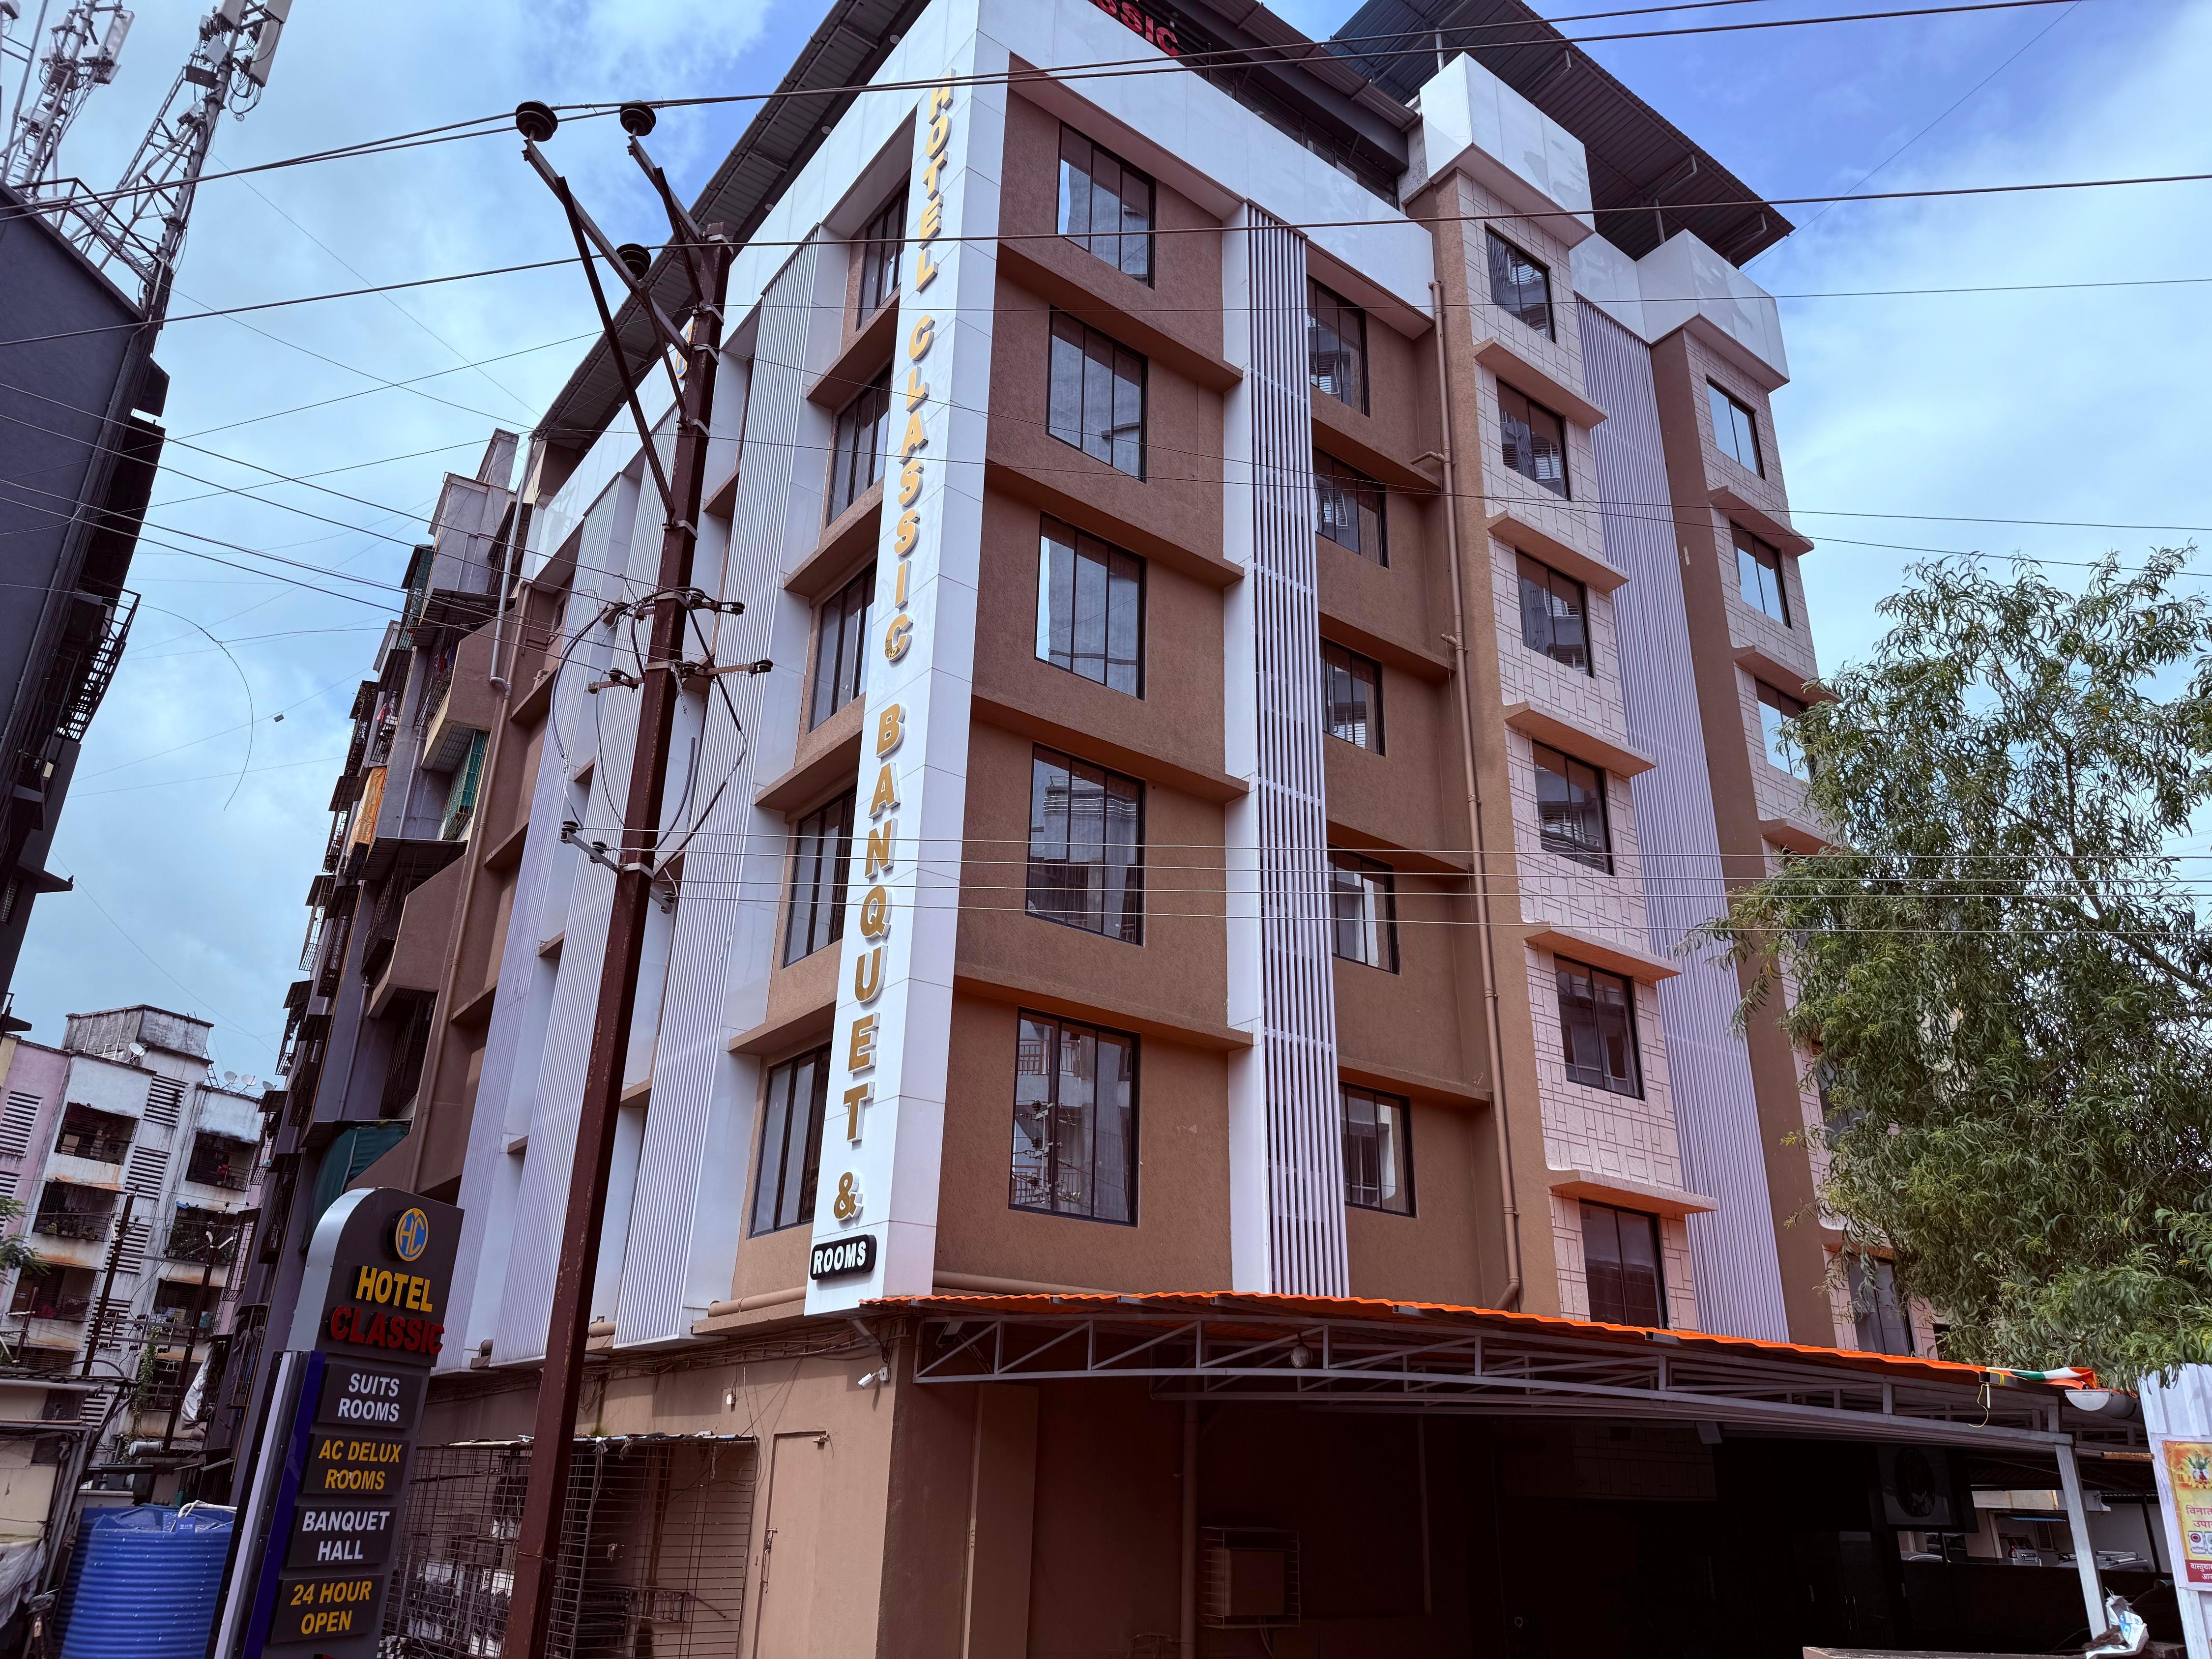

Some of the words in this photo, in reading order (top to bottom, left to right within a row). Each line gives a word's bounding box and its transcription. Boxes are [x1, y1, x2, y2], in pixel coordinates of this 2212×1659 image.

[916, 68, 955, 293] HOTEL
[885, 315, 934, 661] CLASSIC
[844, 703, 905, 1142] BANQUET
[834, 1172, 862, 1221] &
[813, 1241, 867, 1275] ROOMS
[356, 1265, 433, 1312] HOTEL
[330, 1306, 445, 1355] CLASSIC
[349, 1373, 400, 1397] SUITS
[338, 1398, 400, 1422] ROOMS
[318, 1439, 344, 1460] AC
[348, 1441, 403, 1463] DELUX
[324, 1469, 386, 1490] ROOMS
[302, 1511, 390, 1532] BANQUET
[317, 1540, 364, 1561] HALL
[290, 1584, 314, 1605] 24
[319, 1580, 373, 1603] HOUR
[300, 1610, 353, 1634] OPEN
